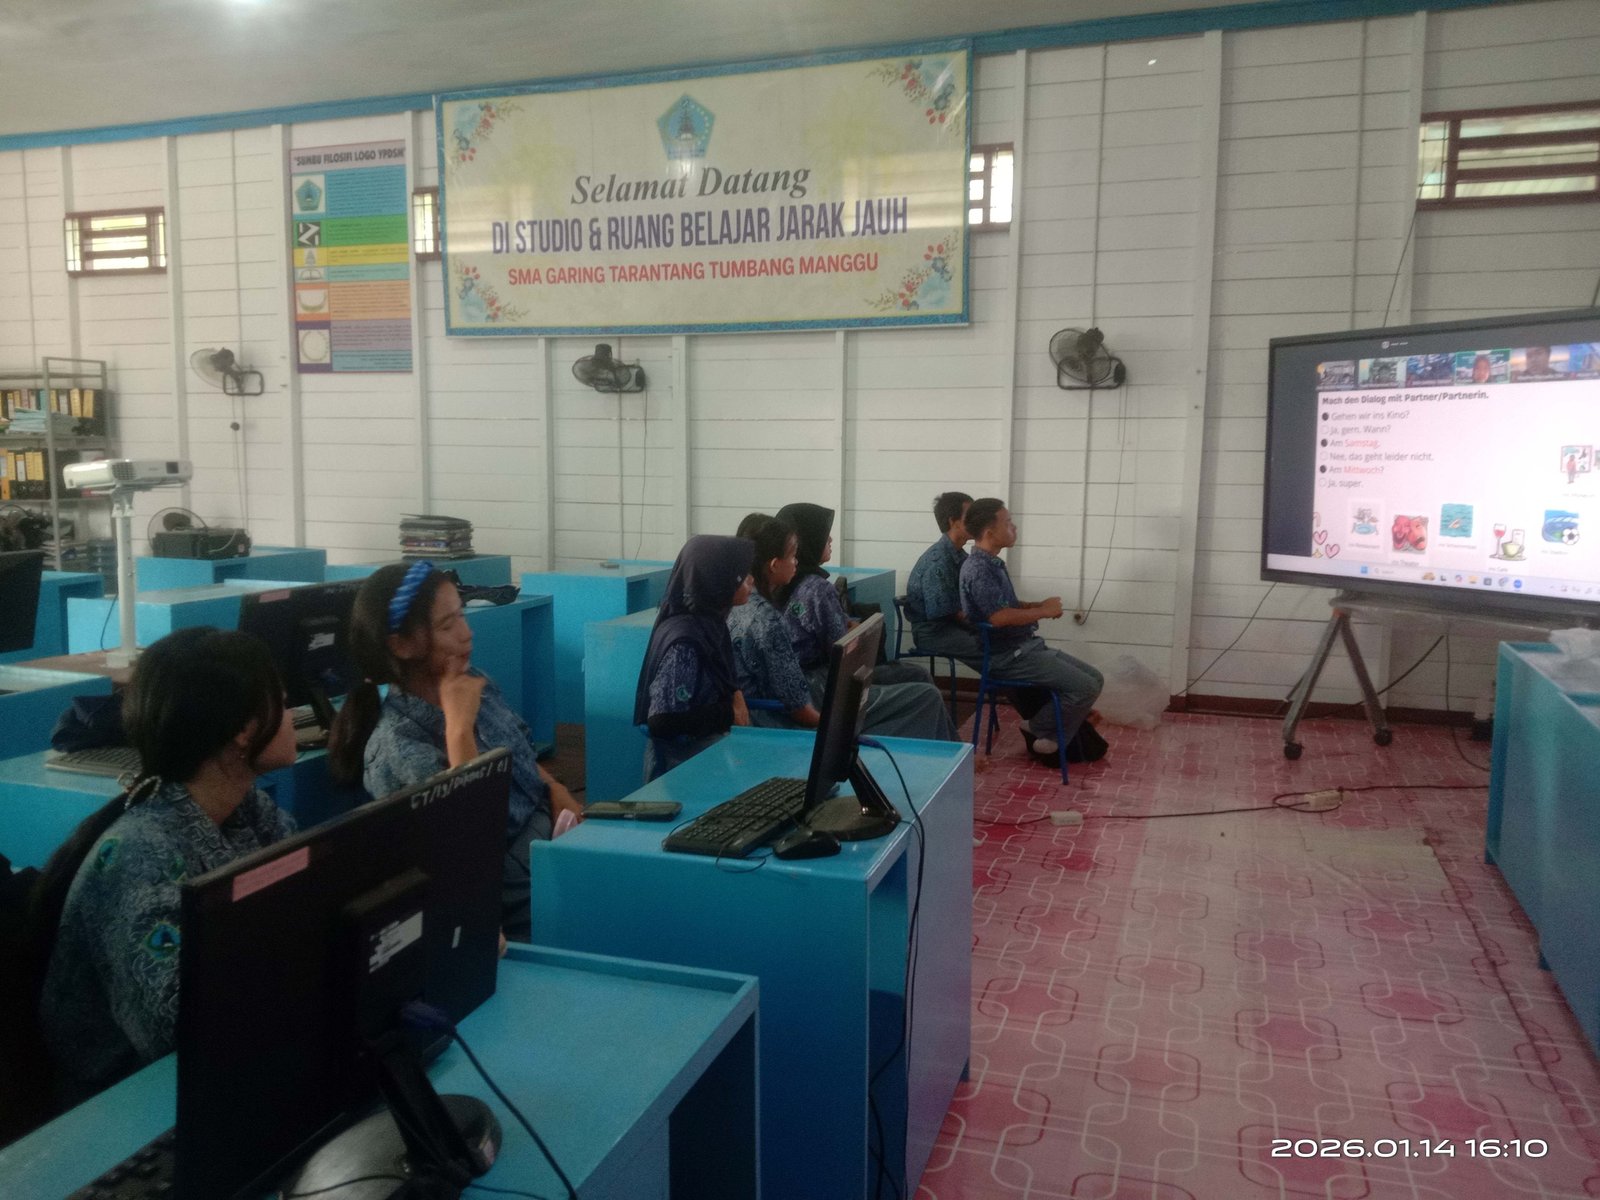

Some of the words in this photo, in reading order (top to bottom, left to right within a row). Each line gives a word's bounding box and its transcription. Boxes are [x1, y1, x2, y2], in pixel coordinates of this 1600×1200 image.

[354, 149, 376, 161] LOGO
[570, 168, 691, 205] Selamat
[699, 165, 811, 199] Datang
[492, 220, 510, 255] DI
[515, 217, 582, 254] STUDIO
[588, 216, 602, 251] &
[607, 210, 674, 250] RUANG
[680, 206, 771, 247] BELAJAR
[776, 201, 844, 242] JARAK
[850, 197, 909, 237] JAUH
[508, 268, 542, 286] SMA
[546, 265, 605, 284] GARING
[609, 261, 705, 283] TARANTANG
[710, 257, 795, 280] TUMBANG
[799, 252, 879, 274] MANGGU
[1322, 397, 1343, 405] Mach
[1345, 396, 1359, 404] den
[1361, 394, 1386, 406] Dialog
[1388, 394, 1402, 403] mit
[1404, 390, 1489, 402] Partner/Partnerin.
[1331, 412, 1357, 420] Gehen
[1359, 412, 1371, 420] wir
[1373, 411, 1385, 419] ins
[1387, 410, 1410, 420] Kino?
[1363, 425, 1391, 434] Wann?
[1330, 439, 1343, 447] Am
[1348, 452, 1363, 460] das
[1365, 452, 1382, 463] geht
[1385, 452, 1408, 461] leider
[1329, 466, 1342, 474] Am
